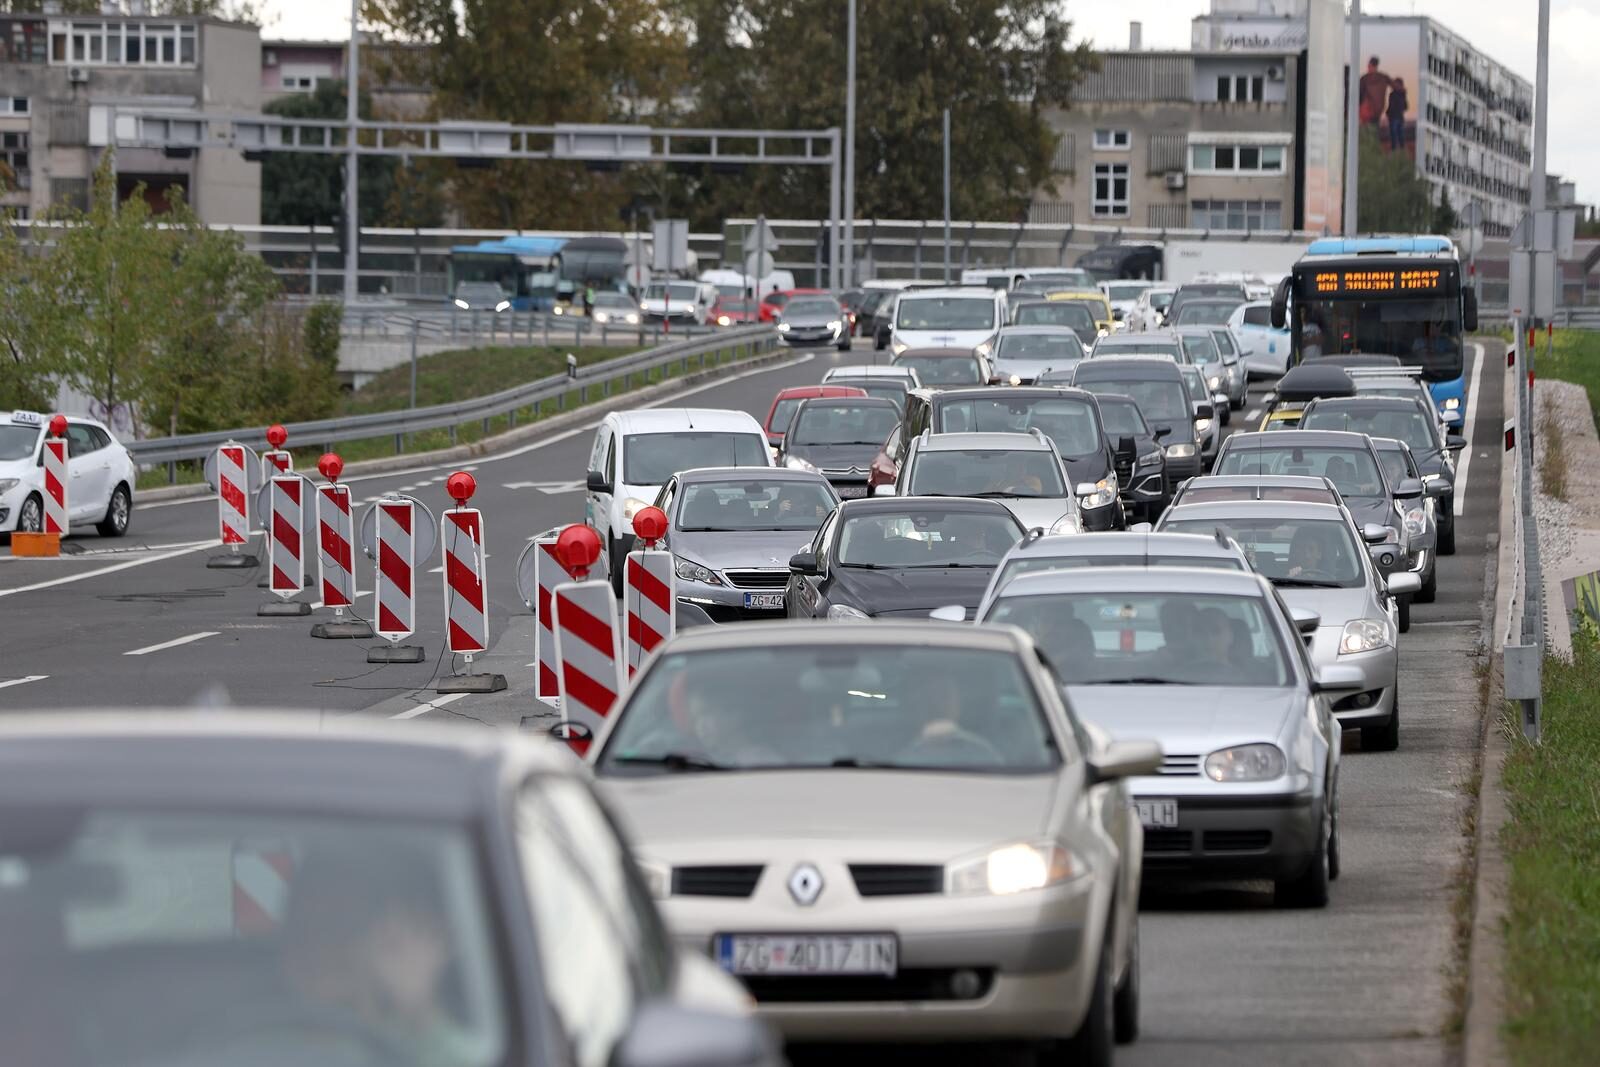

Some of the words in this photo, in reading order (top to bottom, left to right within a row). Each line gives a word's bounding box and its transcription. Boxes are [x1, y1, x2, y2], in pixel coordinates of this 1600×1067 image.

[1401, 270, 1440, 289] MOST
[15, 411, 37, 423] TAXI
[751, 595, 764, 606] ZG
[737, 942, 769, 973] ZG
